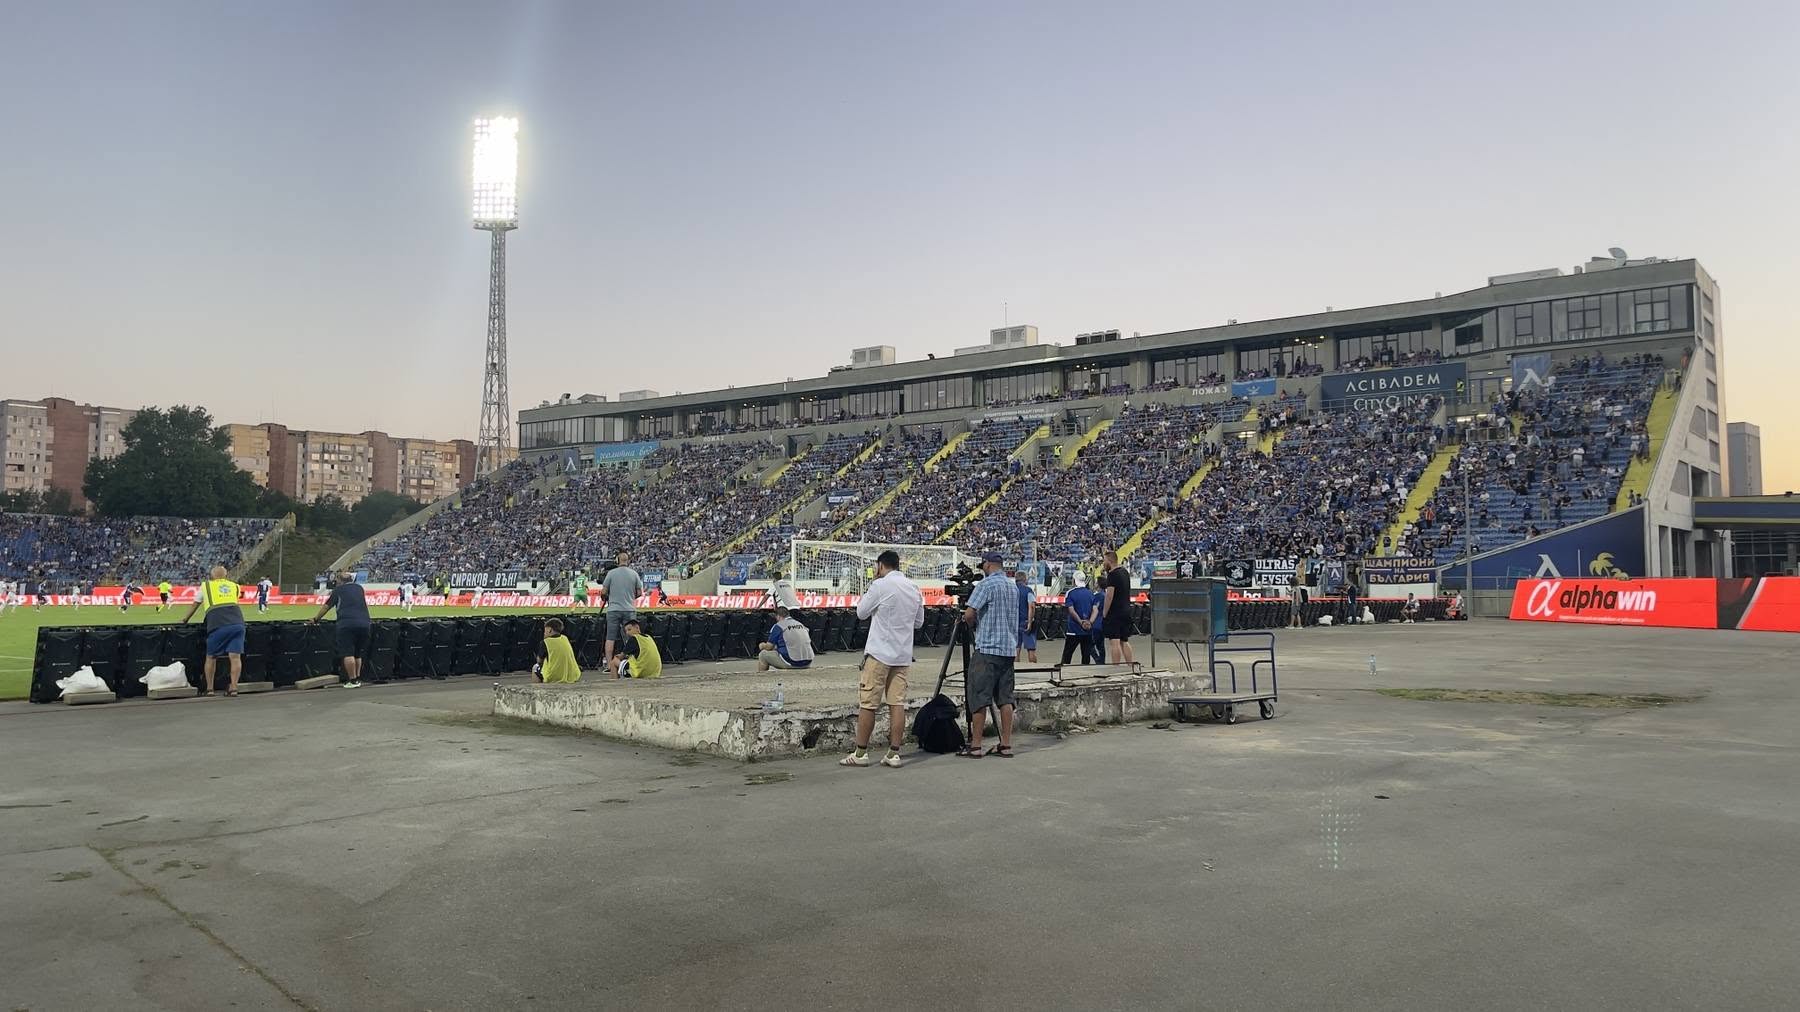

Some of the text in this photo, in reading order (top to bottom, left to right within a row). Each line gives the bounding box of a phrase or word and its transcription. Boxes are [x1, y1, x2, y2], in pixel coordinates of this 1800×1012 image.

[1346, 373, 1440, 392] ACIBADEM
[1255, 559, 1295, 570] ULTRAS
[1366, 559, 1435, 568] ШАМПИОНИ
[451, 573, 488, 587] СИРАКОВ
[1369, 573, 1430, 583] БЪЛГАРИЯ
[482, 595, 515, 606] СТАНИ
[700, 596, 745, 608] СТАНИ
[825, 596, 847, 607] НА
